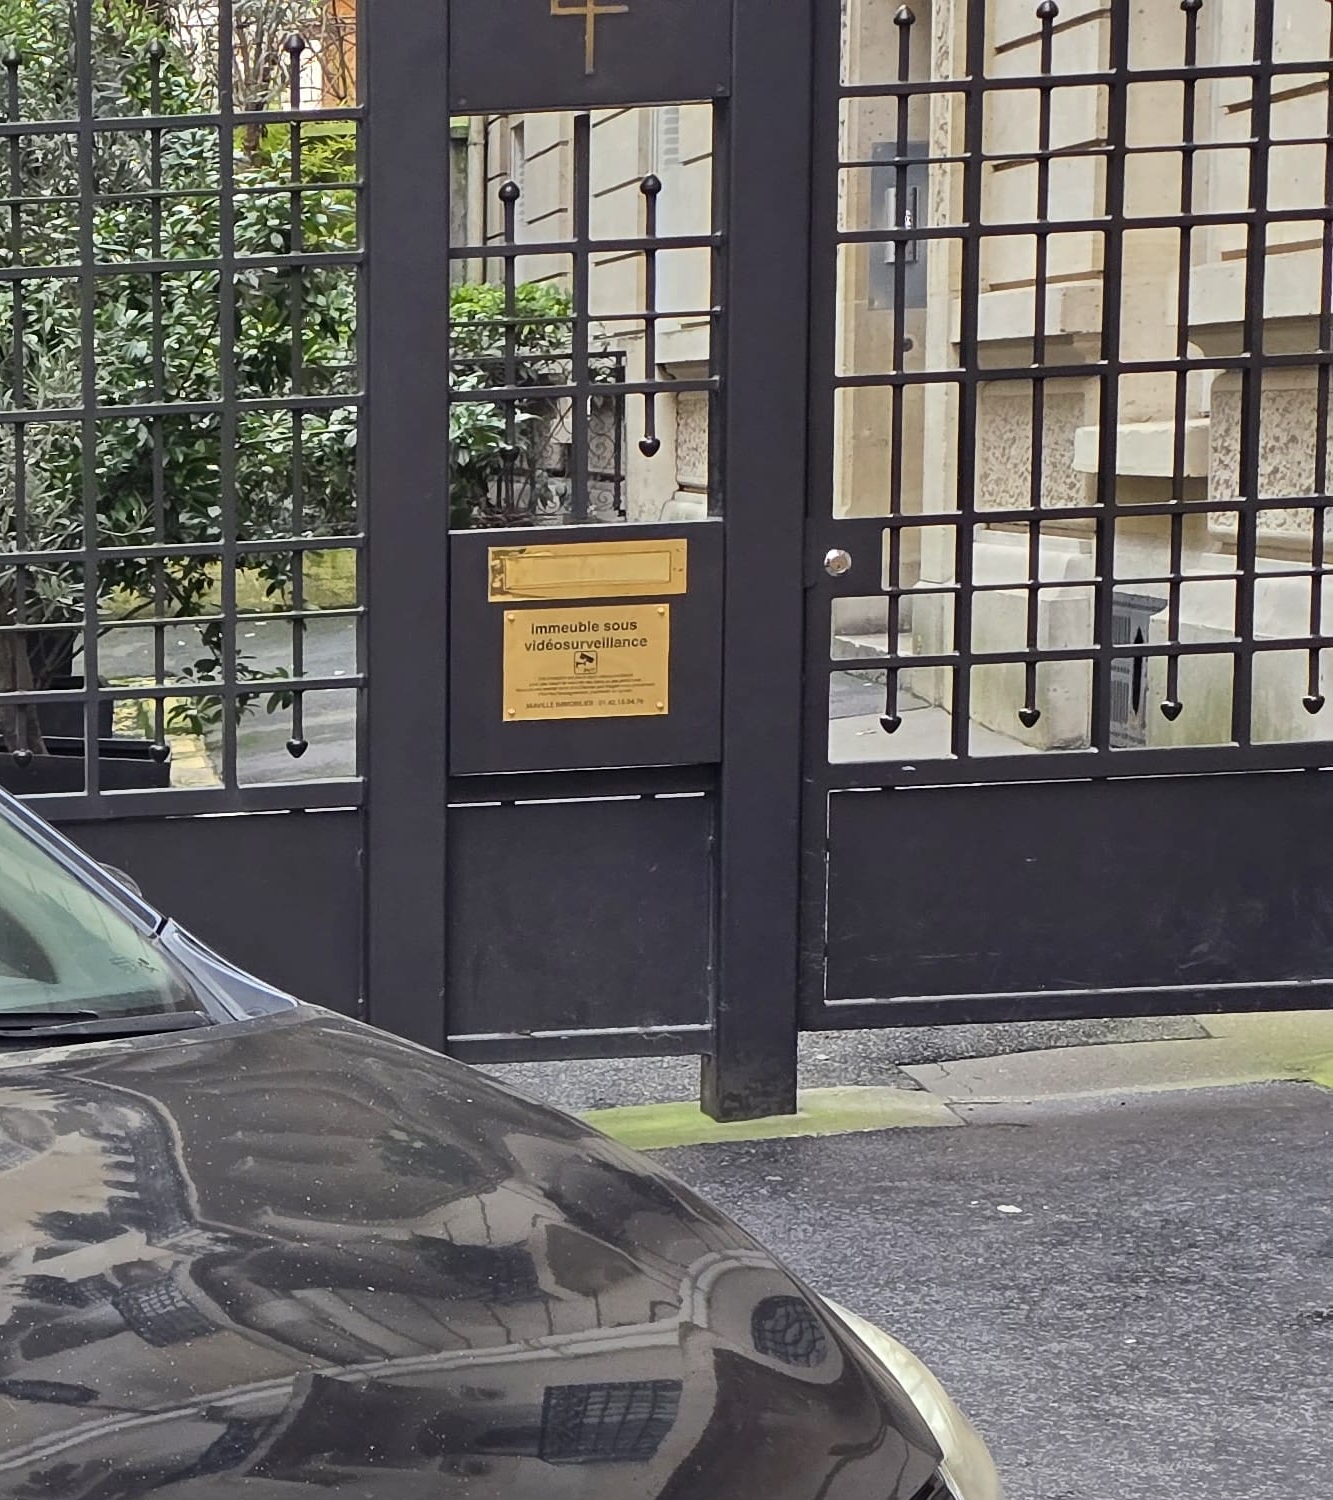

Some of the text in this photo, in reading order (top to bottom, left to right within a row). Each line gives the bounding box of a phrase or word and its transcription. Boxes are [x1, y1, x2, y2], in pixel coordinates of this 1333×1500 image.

[531, 621, 638, 635] Immeuble sous
[524, 637, 648, 652] vidéosurveillance
